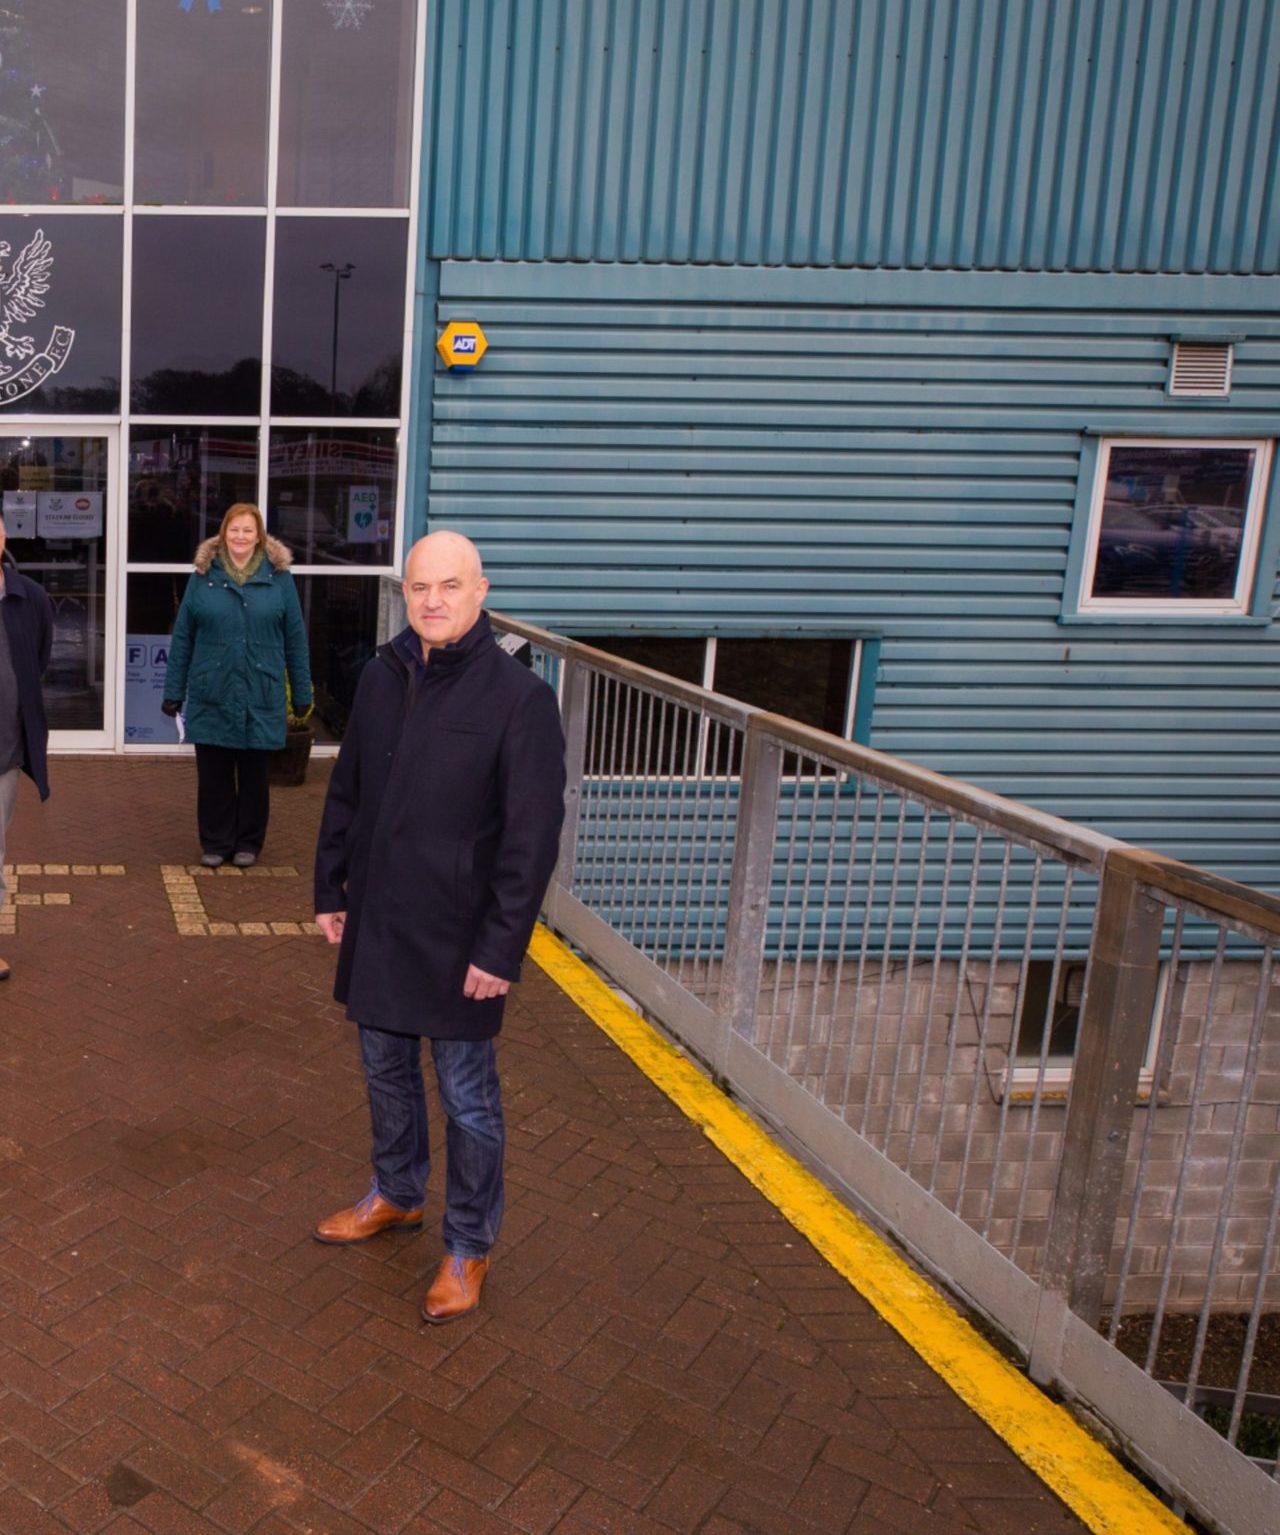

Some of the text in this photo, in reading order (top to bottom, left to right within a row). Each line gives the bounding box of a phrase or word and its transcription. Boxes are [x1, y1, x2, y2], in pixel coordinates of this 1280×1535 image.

[453, 338, 476, 350] ADT
[353, 492, 377, 502] AED
[129, 647, 168, 664] F A
